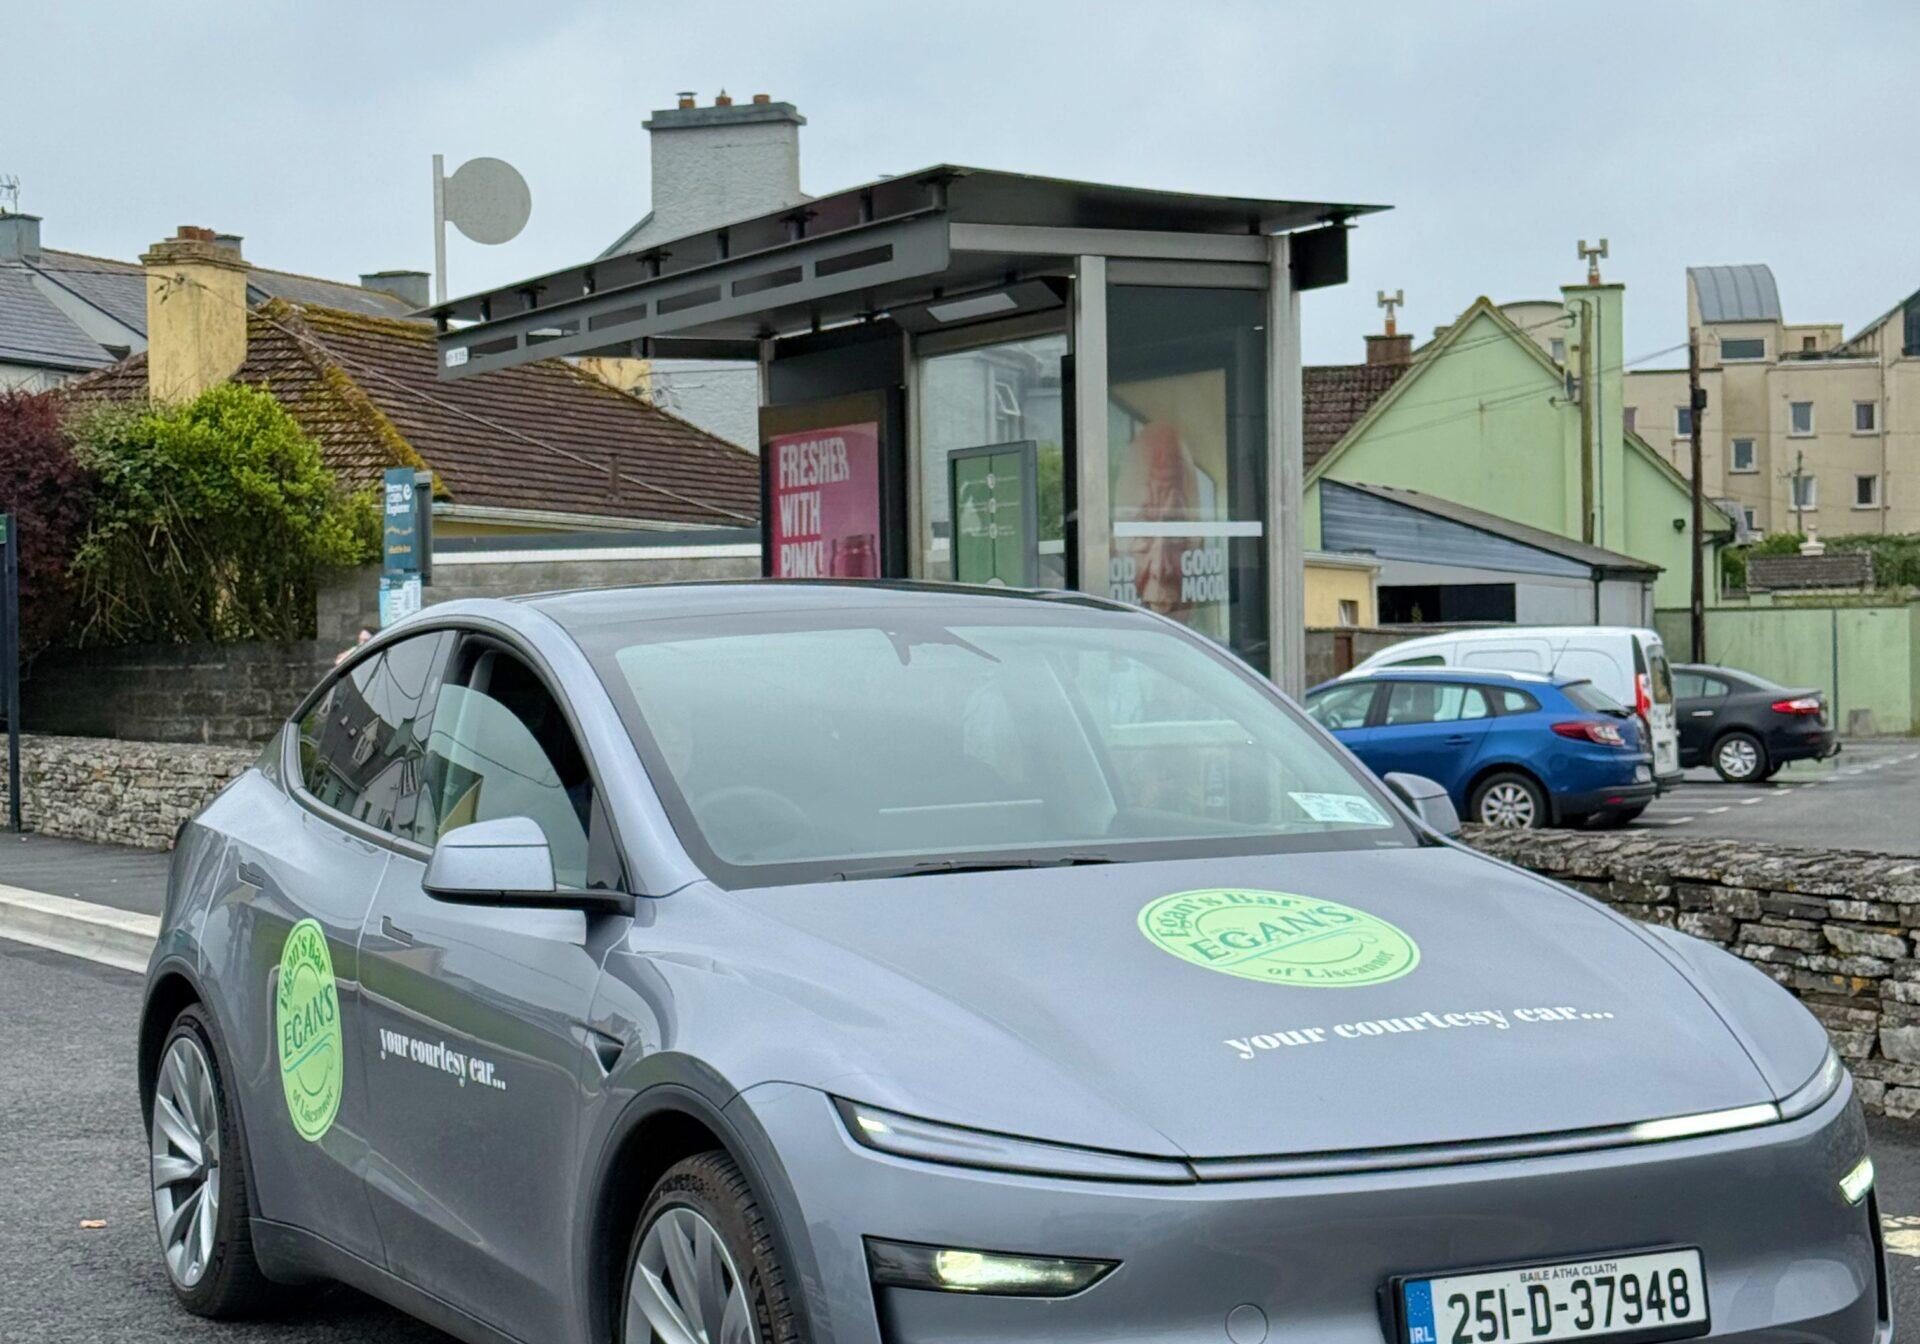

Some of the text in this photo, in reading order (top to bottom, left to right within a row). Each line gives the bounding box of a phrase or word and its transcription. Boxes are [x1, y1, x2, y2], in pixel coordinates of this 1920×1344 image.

[779, 437, 849, 489] FRESHER
[779, 491, 820, 538] WITH
[1181, 549, 1222, 576] GOOD
[1156, 893, 1301, 937] Egan's Bar
[1189, 905, 1355, 961] EGAN'S
[1267, 967, 1297, 977] of
[284, 983, 334, 1059] EGAN'S
[1223, 1005, 1614, 1060] your courtesy car...
[379, 1028, 506, 1091] your courtesy car...
[1520, 1262, 1618, 1283] BAILE ÁTHA CLIATH
[1447, 1268, 1691, 1344] 251-D-37948
[1409, 1326, 1434, 1344] IRL
